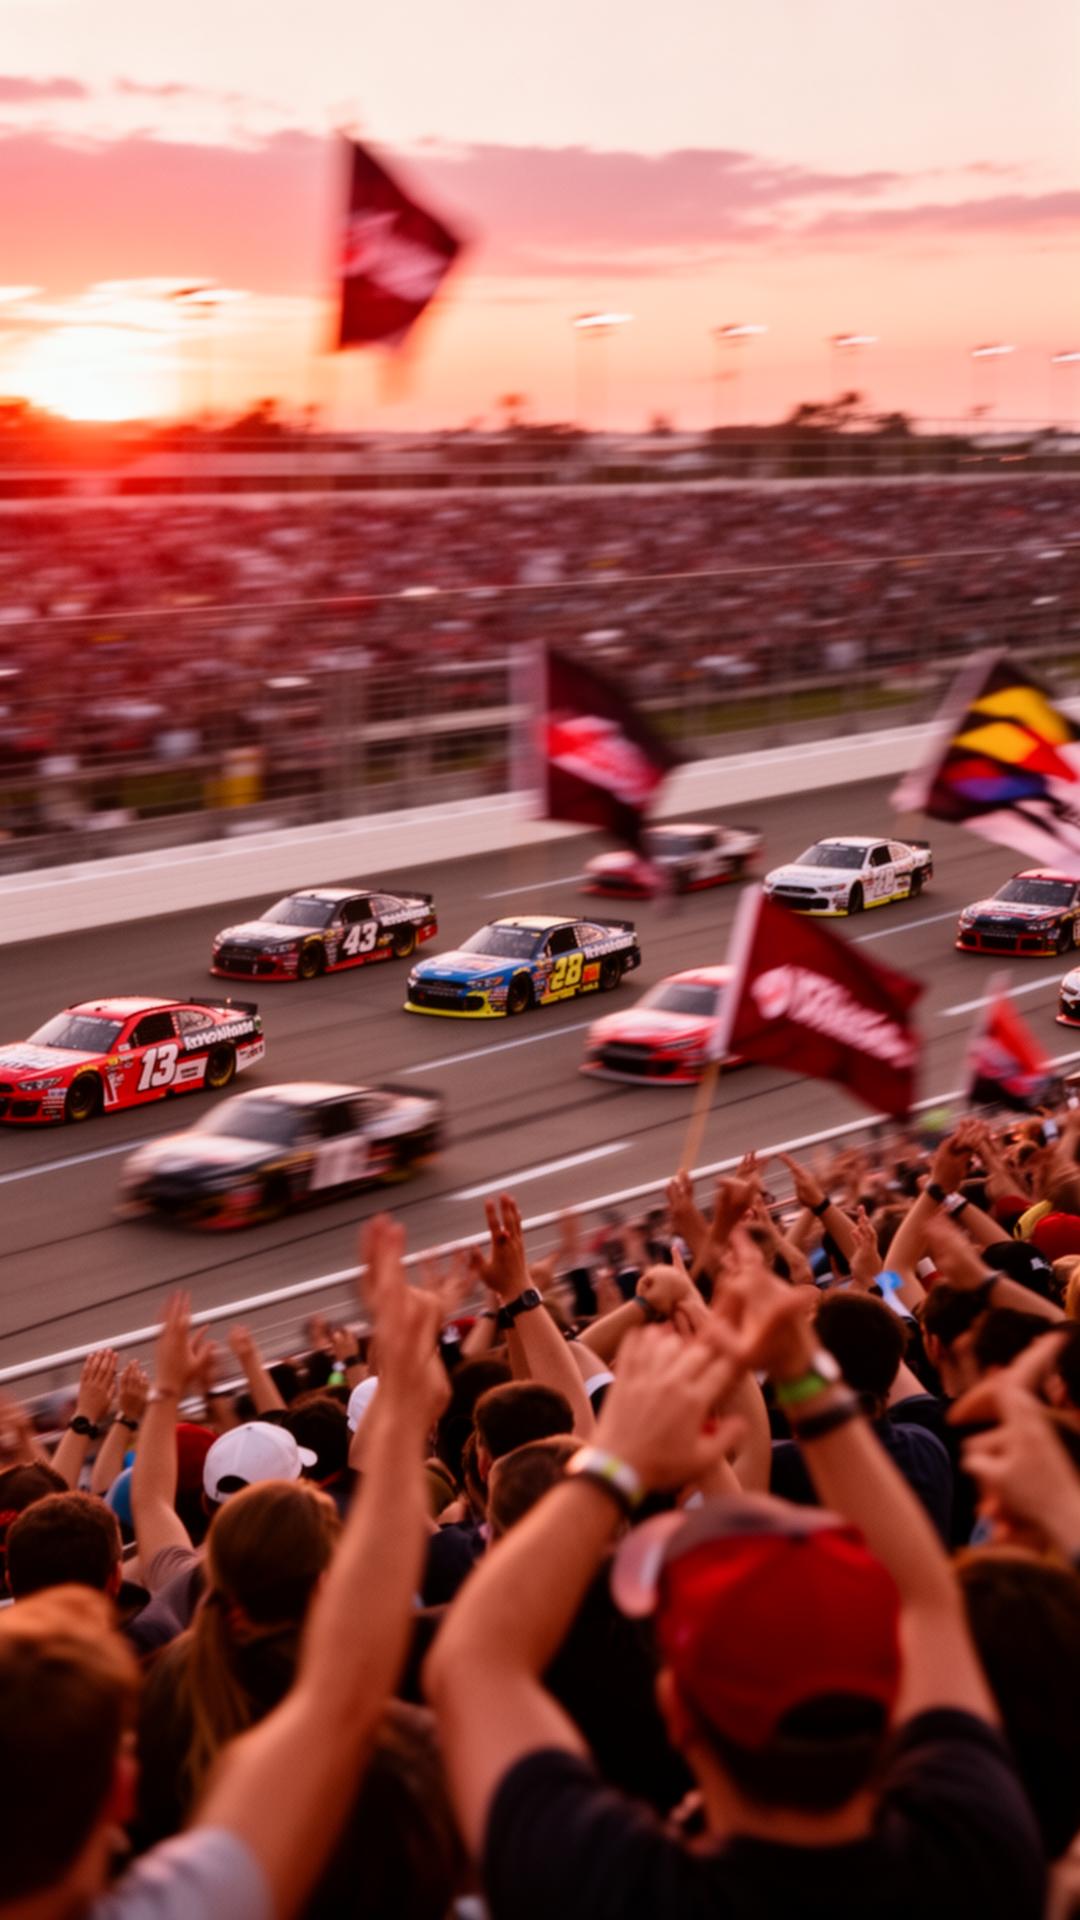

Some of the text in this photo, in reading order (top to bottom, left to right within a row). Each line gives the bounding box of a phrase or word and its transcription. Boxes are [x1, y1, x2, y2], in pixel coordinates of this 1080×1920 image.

[343, 922, 379, 955] 43
[550, 952, 585, 990] 28
[137, 1043, 179, 1092] 13
